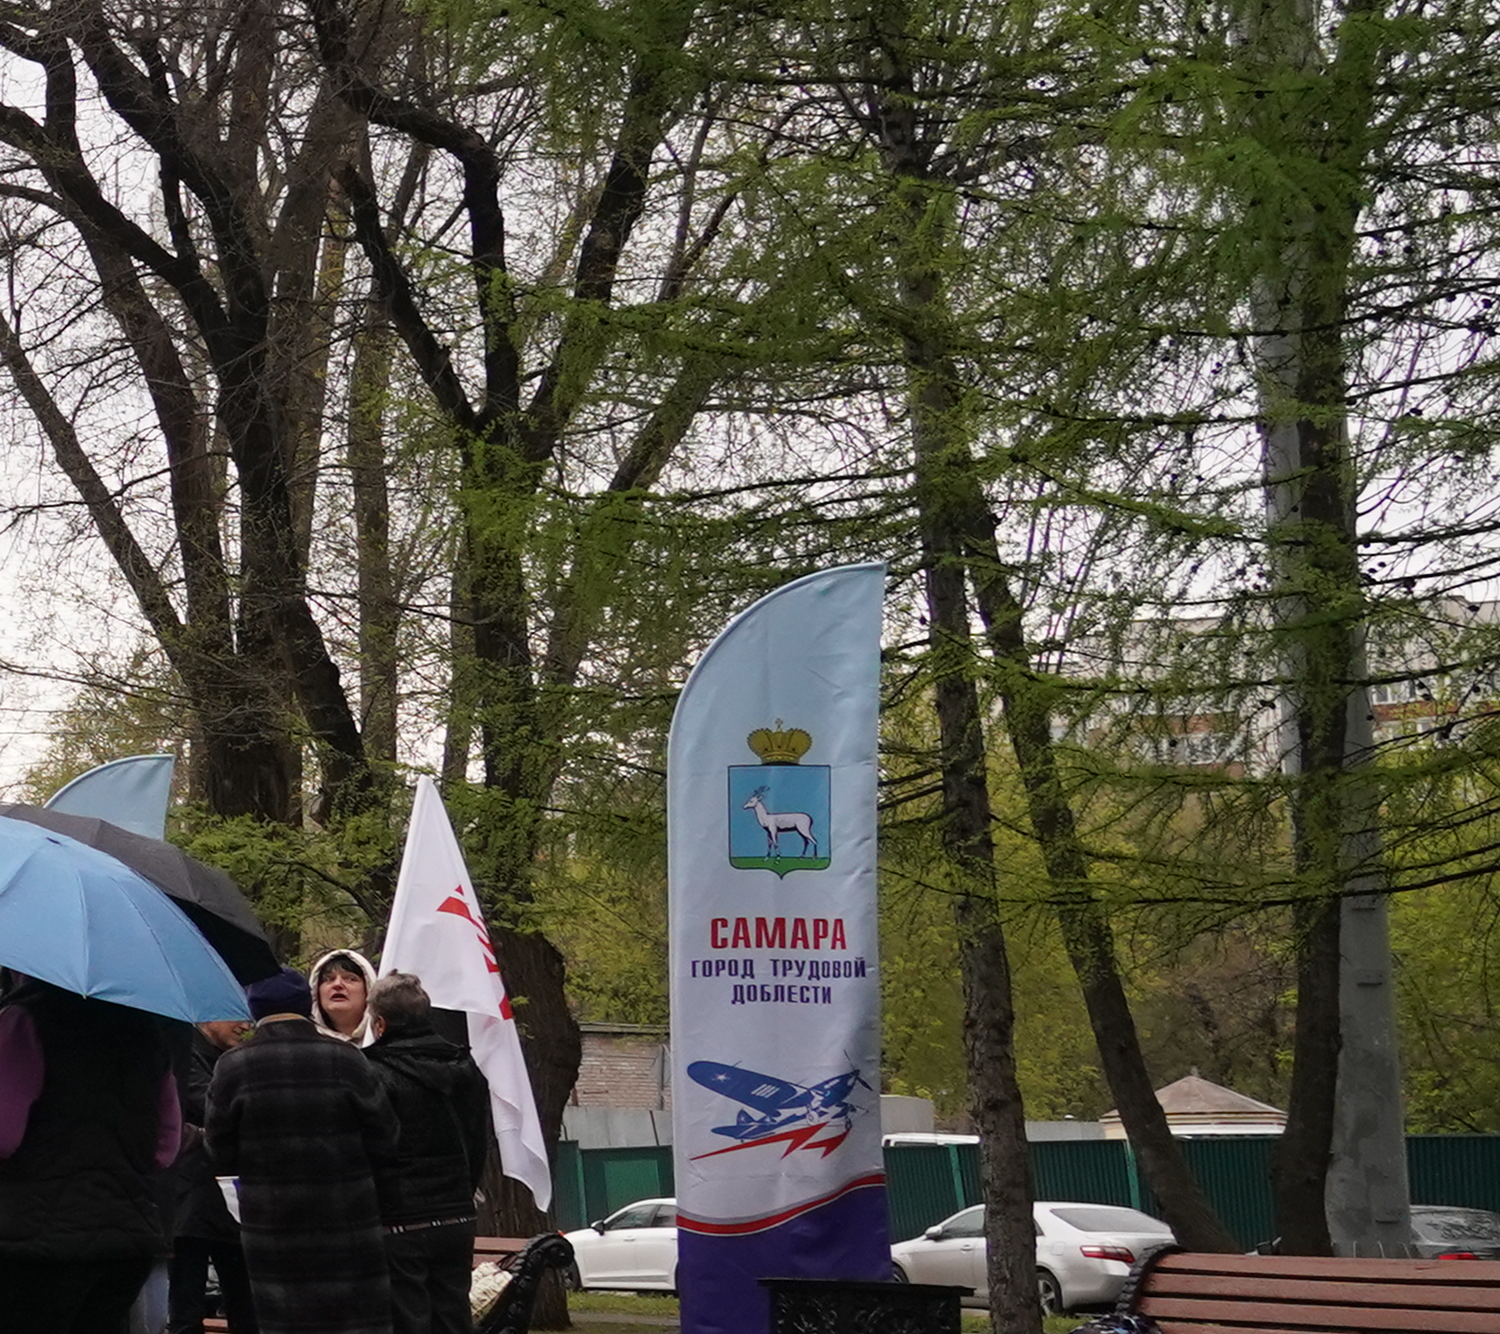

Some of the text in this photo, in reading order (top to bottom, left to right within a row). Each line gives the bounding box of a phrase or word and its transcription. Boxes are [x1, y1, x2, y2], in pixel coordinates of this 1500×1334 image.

[710, 916, 848, 950] САМАРА
[691, 956, 867, 981] ГОРОД ТРУДОВОЙ
[730, 983, 833, 1005] ДОБЛЕСТИ
